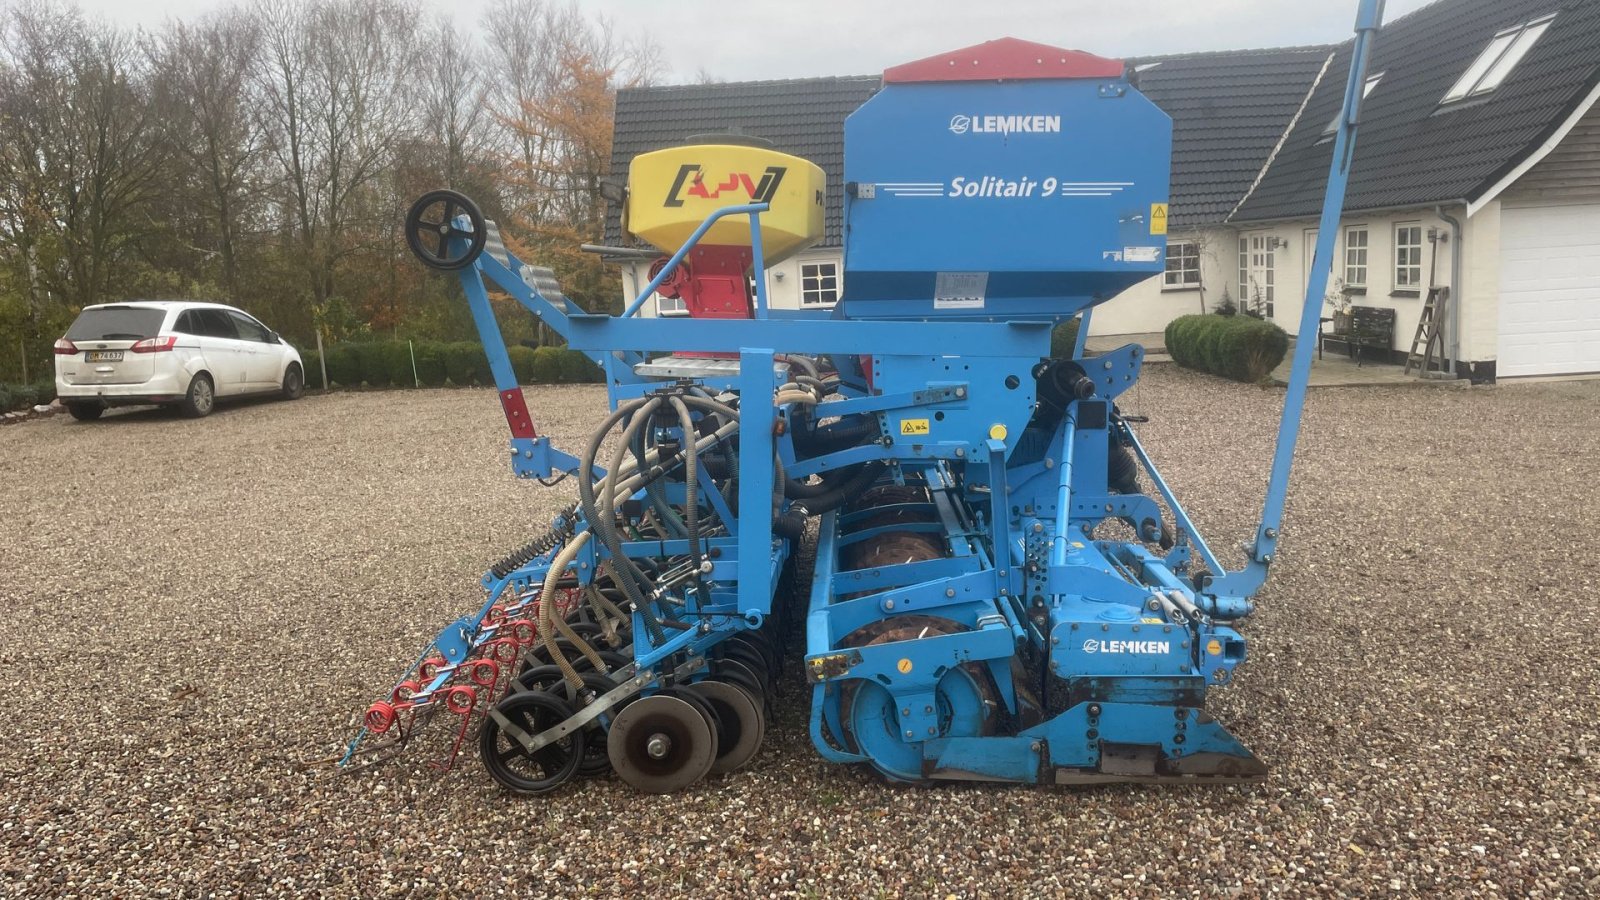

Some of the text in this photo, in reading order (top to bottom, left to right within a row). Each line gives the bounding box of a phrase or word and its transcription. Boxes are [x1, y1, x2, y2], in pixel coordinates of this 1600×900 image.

[972, 115, 1061, 137] LEMKEN
[948, 176, 1058, 198] Solitair 9
[1100, 640, 1170, 654] LEMKEN
